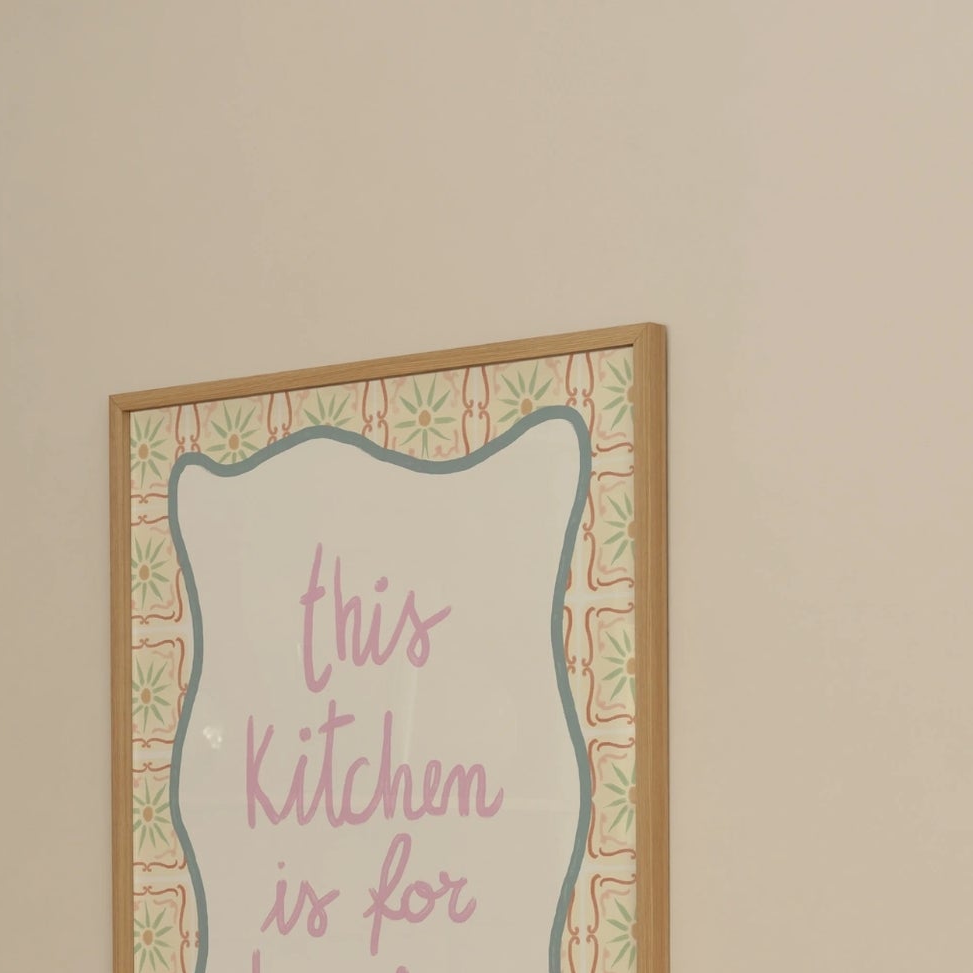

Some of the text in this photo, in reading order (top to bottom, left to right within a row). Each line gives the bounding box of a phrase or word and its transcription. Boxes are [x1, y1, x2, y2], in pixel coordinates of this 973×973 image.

[300, 543, 451, 693] this
[260, 832, 477, 956] is for
